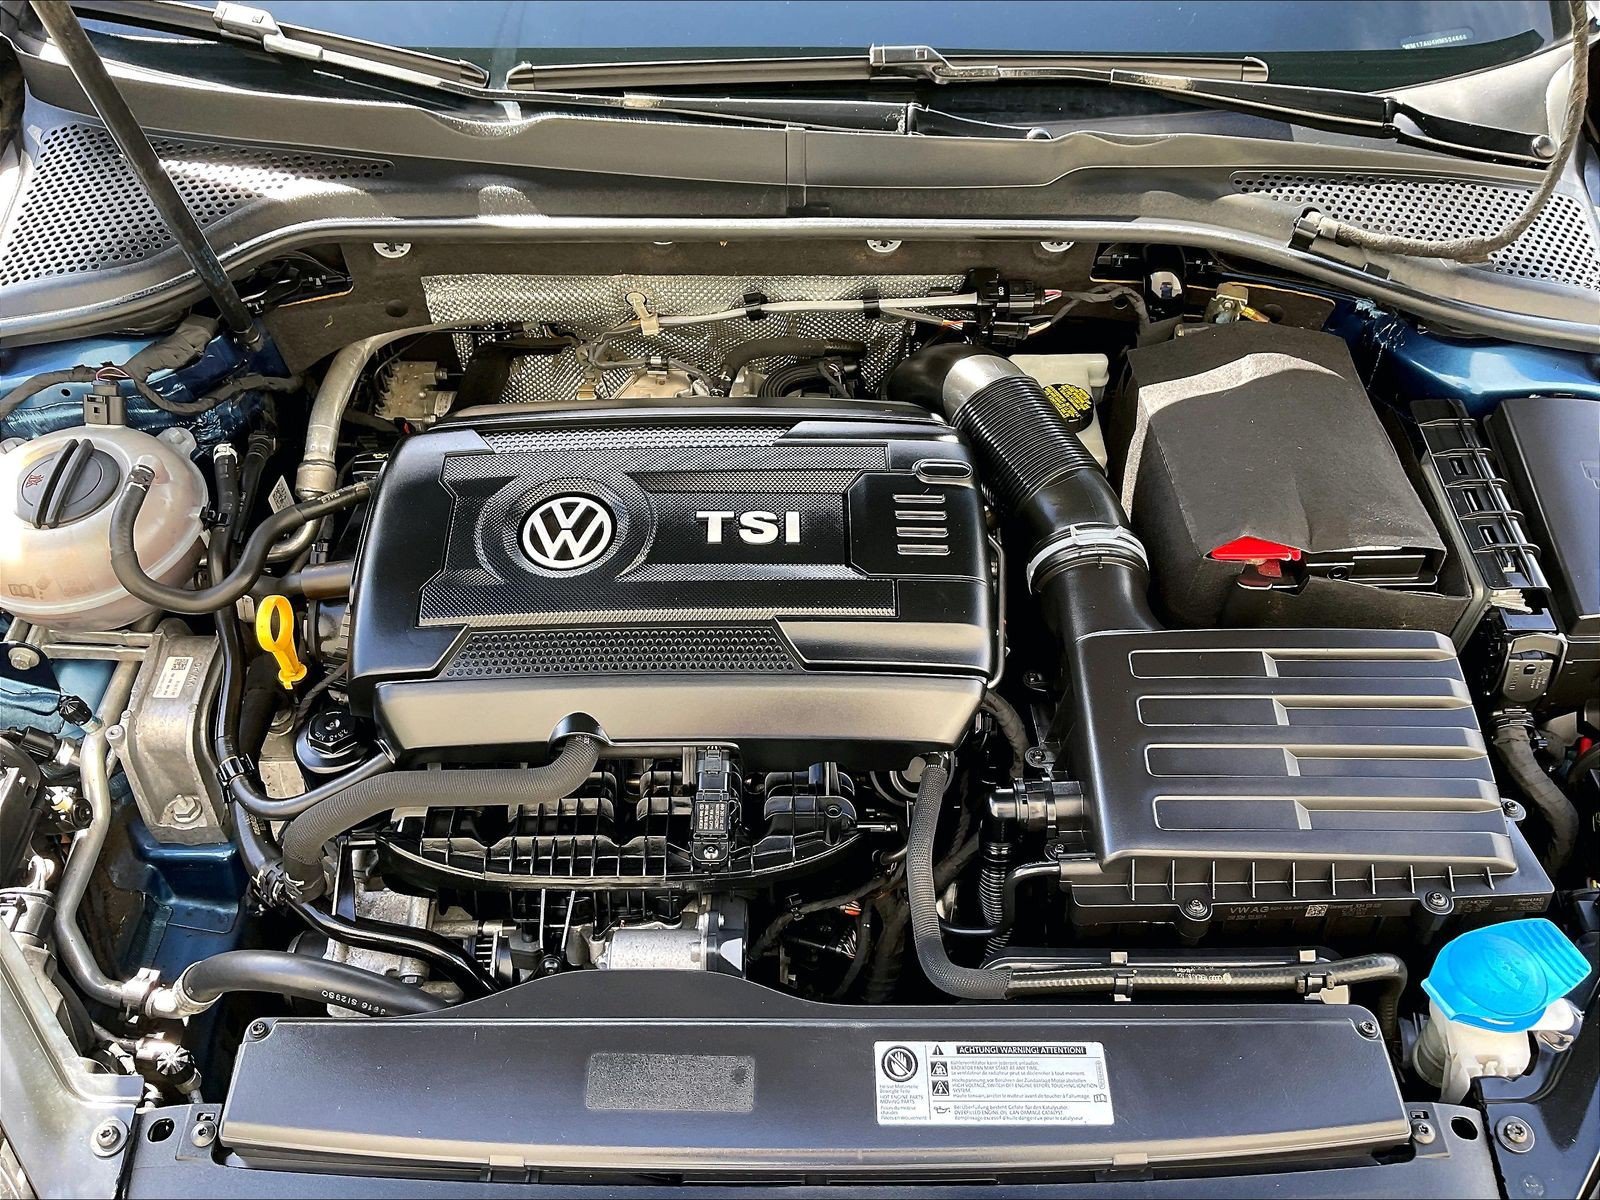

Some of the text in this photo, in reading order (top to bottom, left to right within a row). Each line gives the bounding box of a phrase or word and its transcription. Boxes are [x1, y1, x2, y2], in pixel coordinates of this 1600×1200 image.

[696, 511, 800, 544] TSI
[1230, 906, 1250, 914] VW
[1251, 905, 1269, 913] AG
[960, 1046, 1084, 1054] ACHTUNG! WARNING! ATTENTION!
